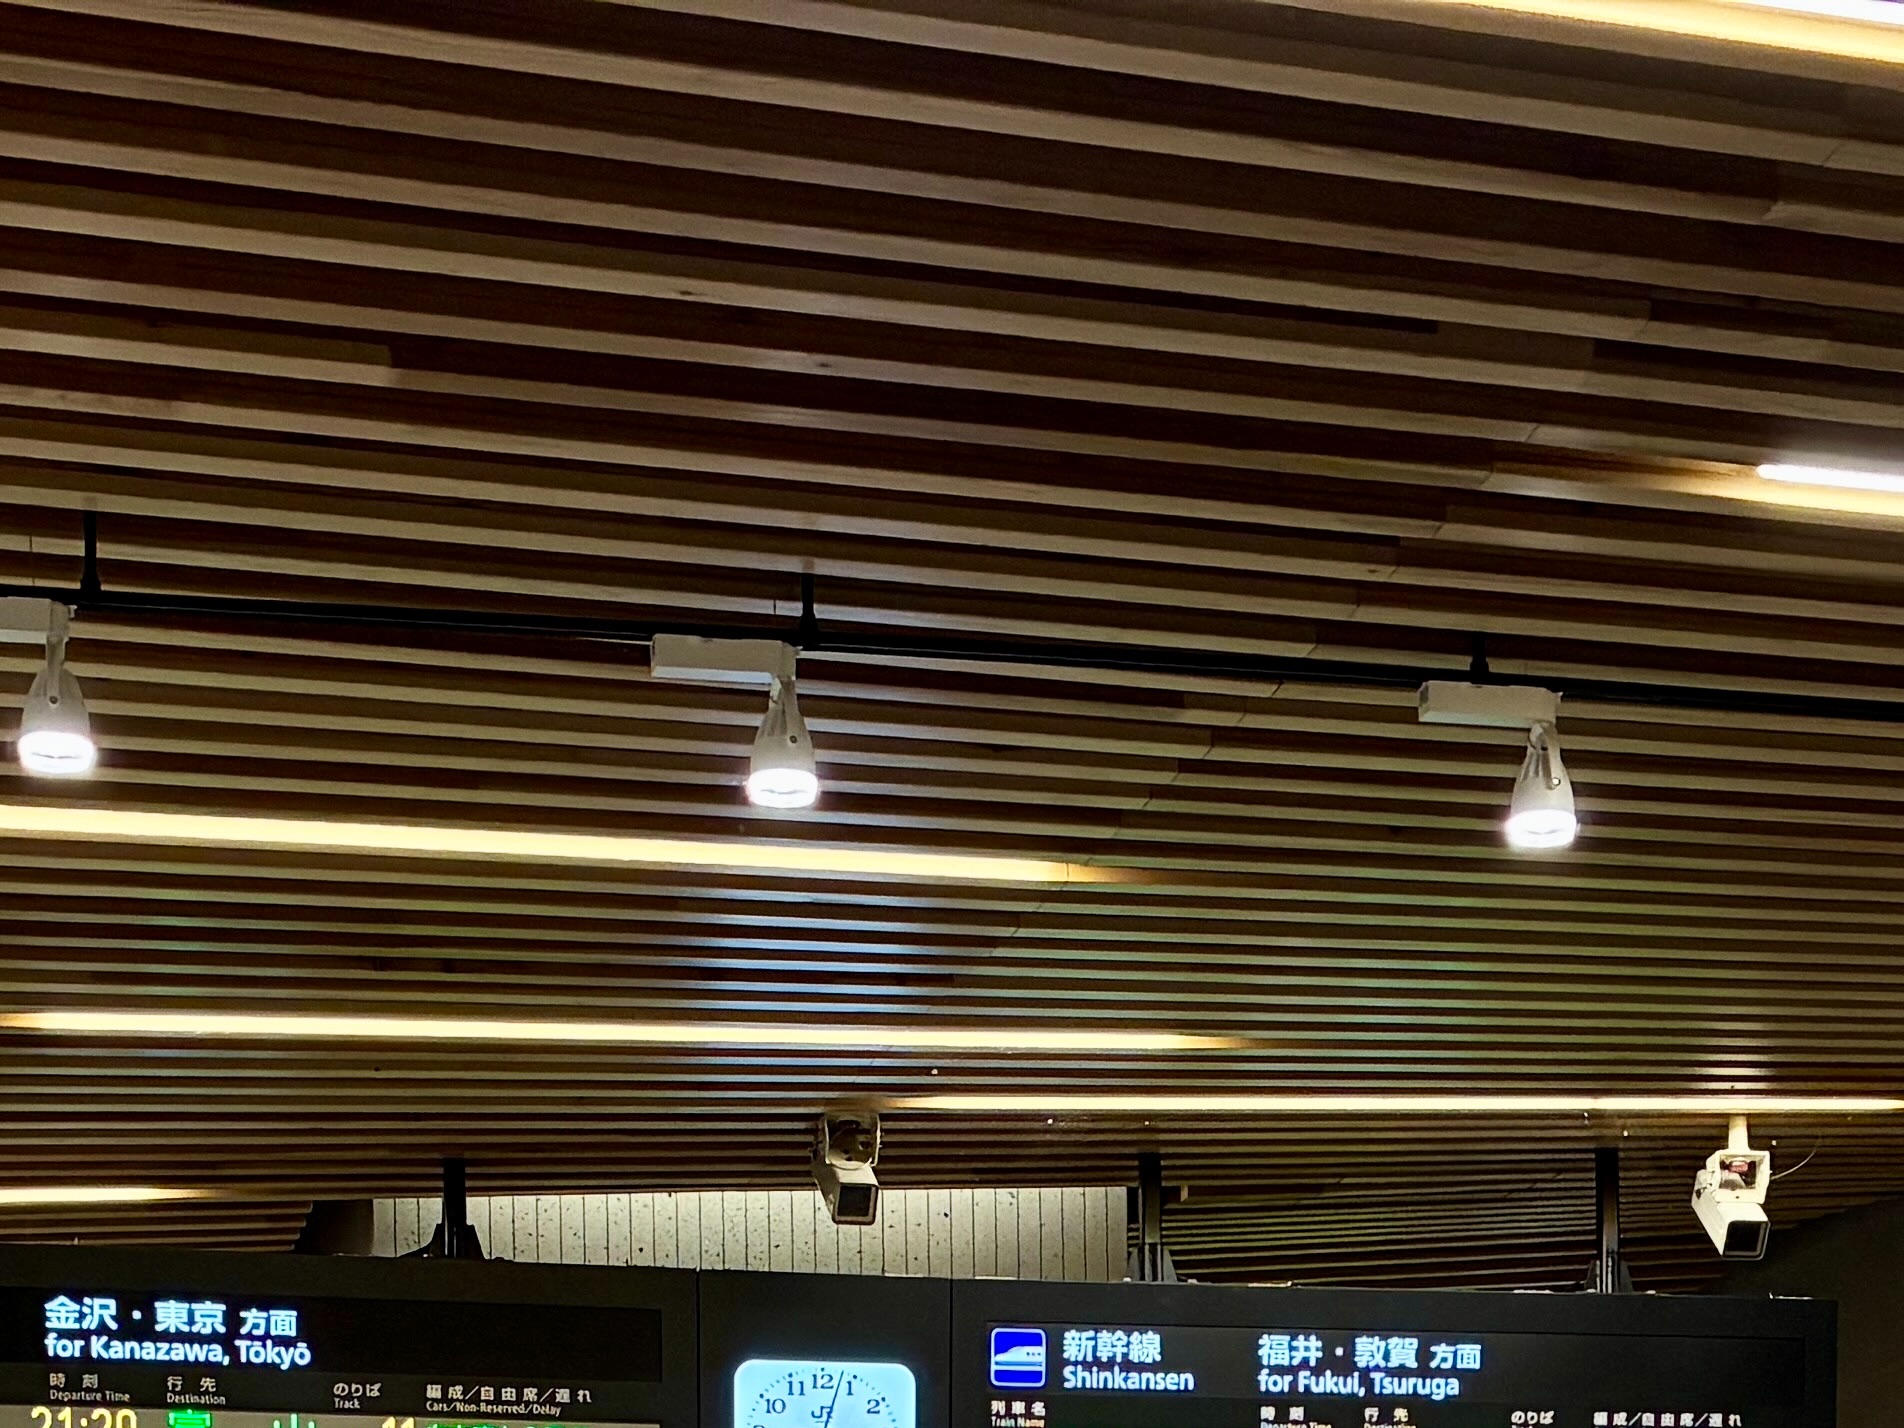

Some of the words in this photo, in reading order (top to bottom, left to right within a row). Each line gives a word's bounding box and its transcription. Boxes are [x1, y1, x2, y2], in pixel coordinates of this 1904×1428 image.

[44, 1295, 226, 1334] 金沢・東京
[240, 1309, 297, 1337] 方面
[45, 1334, 84, 1359] for
[90, 1335, 230, 1366] Kanazawa,
[235, 1340, 311, 1370] Tōkyō
[1063, 1330, 1161, 1363] 新幹線
[1258, 1333, 1418, 1369] 福井・敦賀
[1430, 1344, 1481, 1371] 方面
[167, 1377, 216, 1392] 行先
[334, 1382, 381, 1397] のりば
[787, 1380, 806, 1396] 11
[812, 1374, 834, 1390] 12
[846, 1380, 854, 1396] 1
[1063, 1366, 1195, 1391] Shinkansen
[1258, 1371, 1293, 1392] for
[1298, 1373, 1365, 1397] Fukui,
[1370, 1372, 1459, 1400] Tsuruga
[50, 1390, 102, 1402] Departure
[106, 1391, 130, 1402] Time
[166, 1392, 225, 1405] Destination
[334, 1398, 360, 1409] Track
[765, 1398, 786, 1414] 10
[866, 1399, 881, 1414] 2
[1511, 1411, 1553, 1425] のりば
